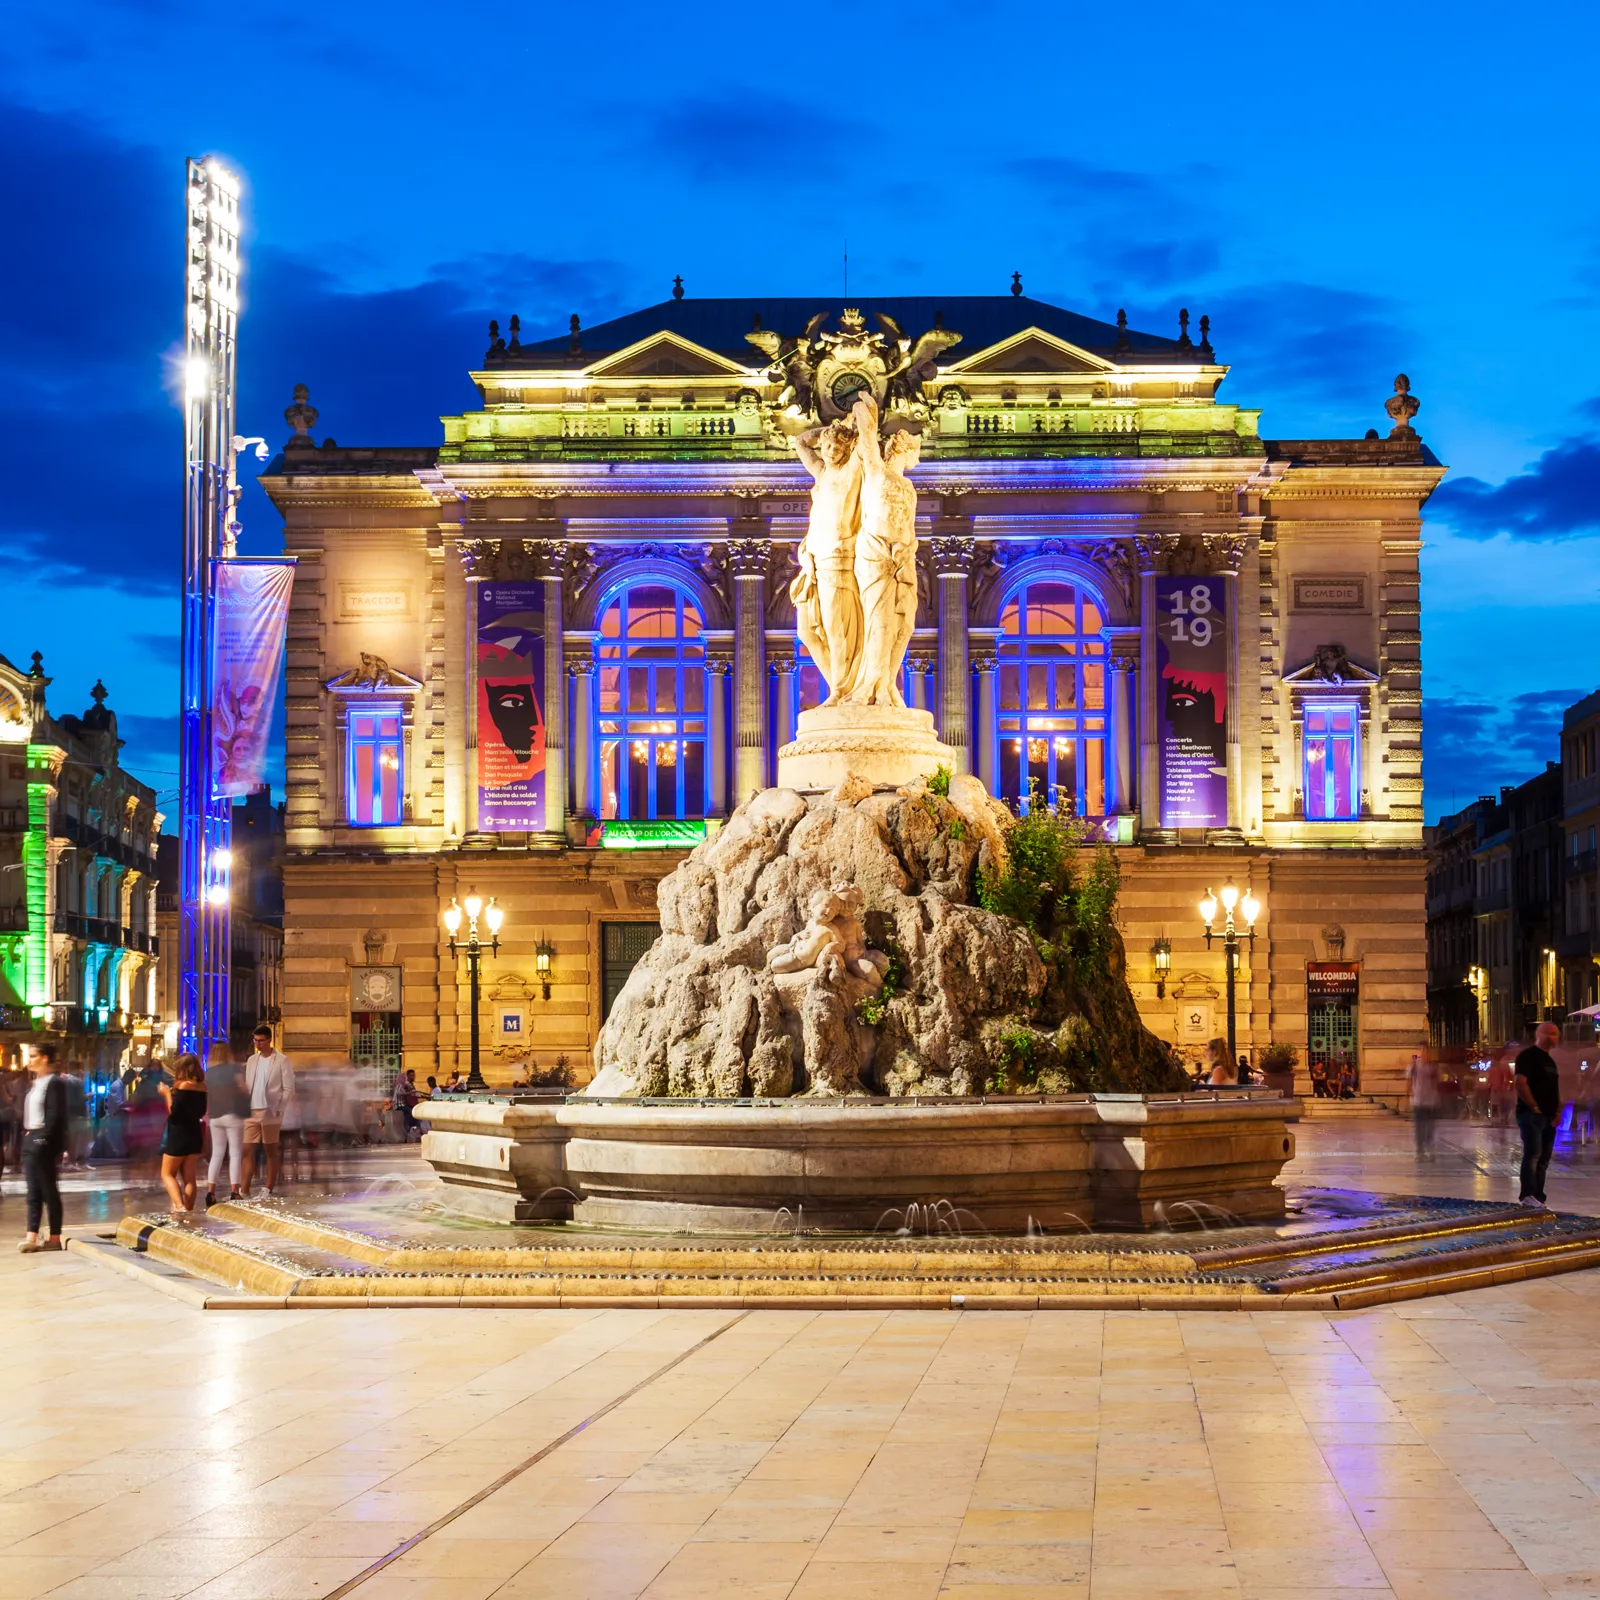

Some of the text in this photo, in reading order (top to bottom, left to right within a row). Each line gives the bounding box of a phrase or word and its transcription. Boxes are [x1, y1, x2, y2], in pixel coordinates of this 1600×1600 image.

[1305, 590, 1353, 598] COMEDIE
[1170, 585, 1212, 614] 18
[1170, 617, 1212, 647] 19
[1309, 972, 1356, 980] WELCOMEDIA
[506, 1020, 518, 1030] M
